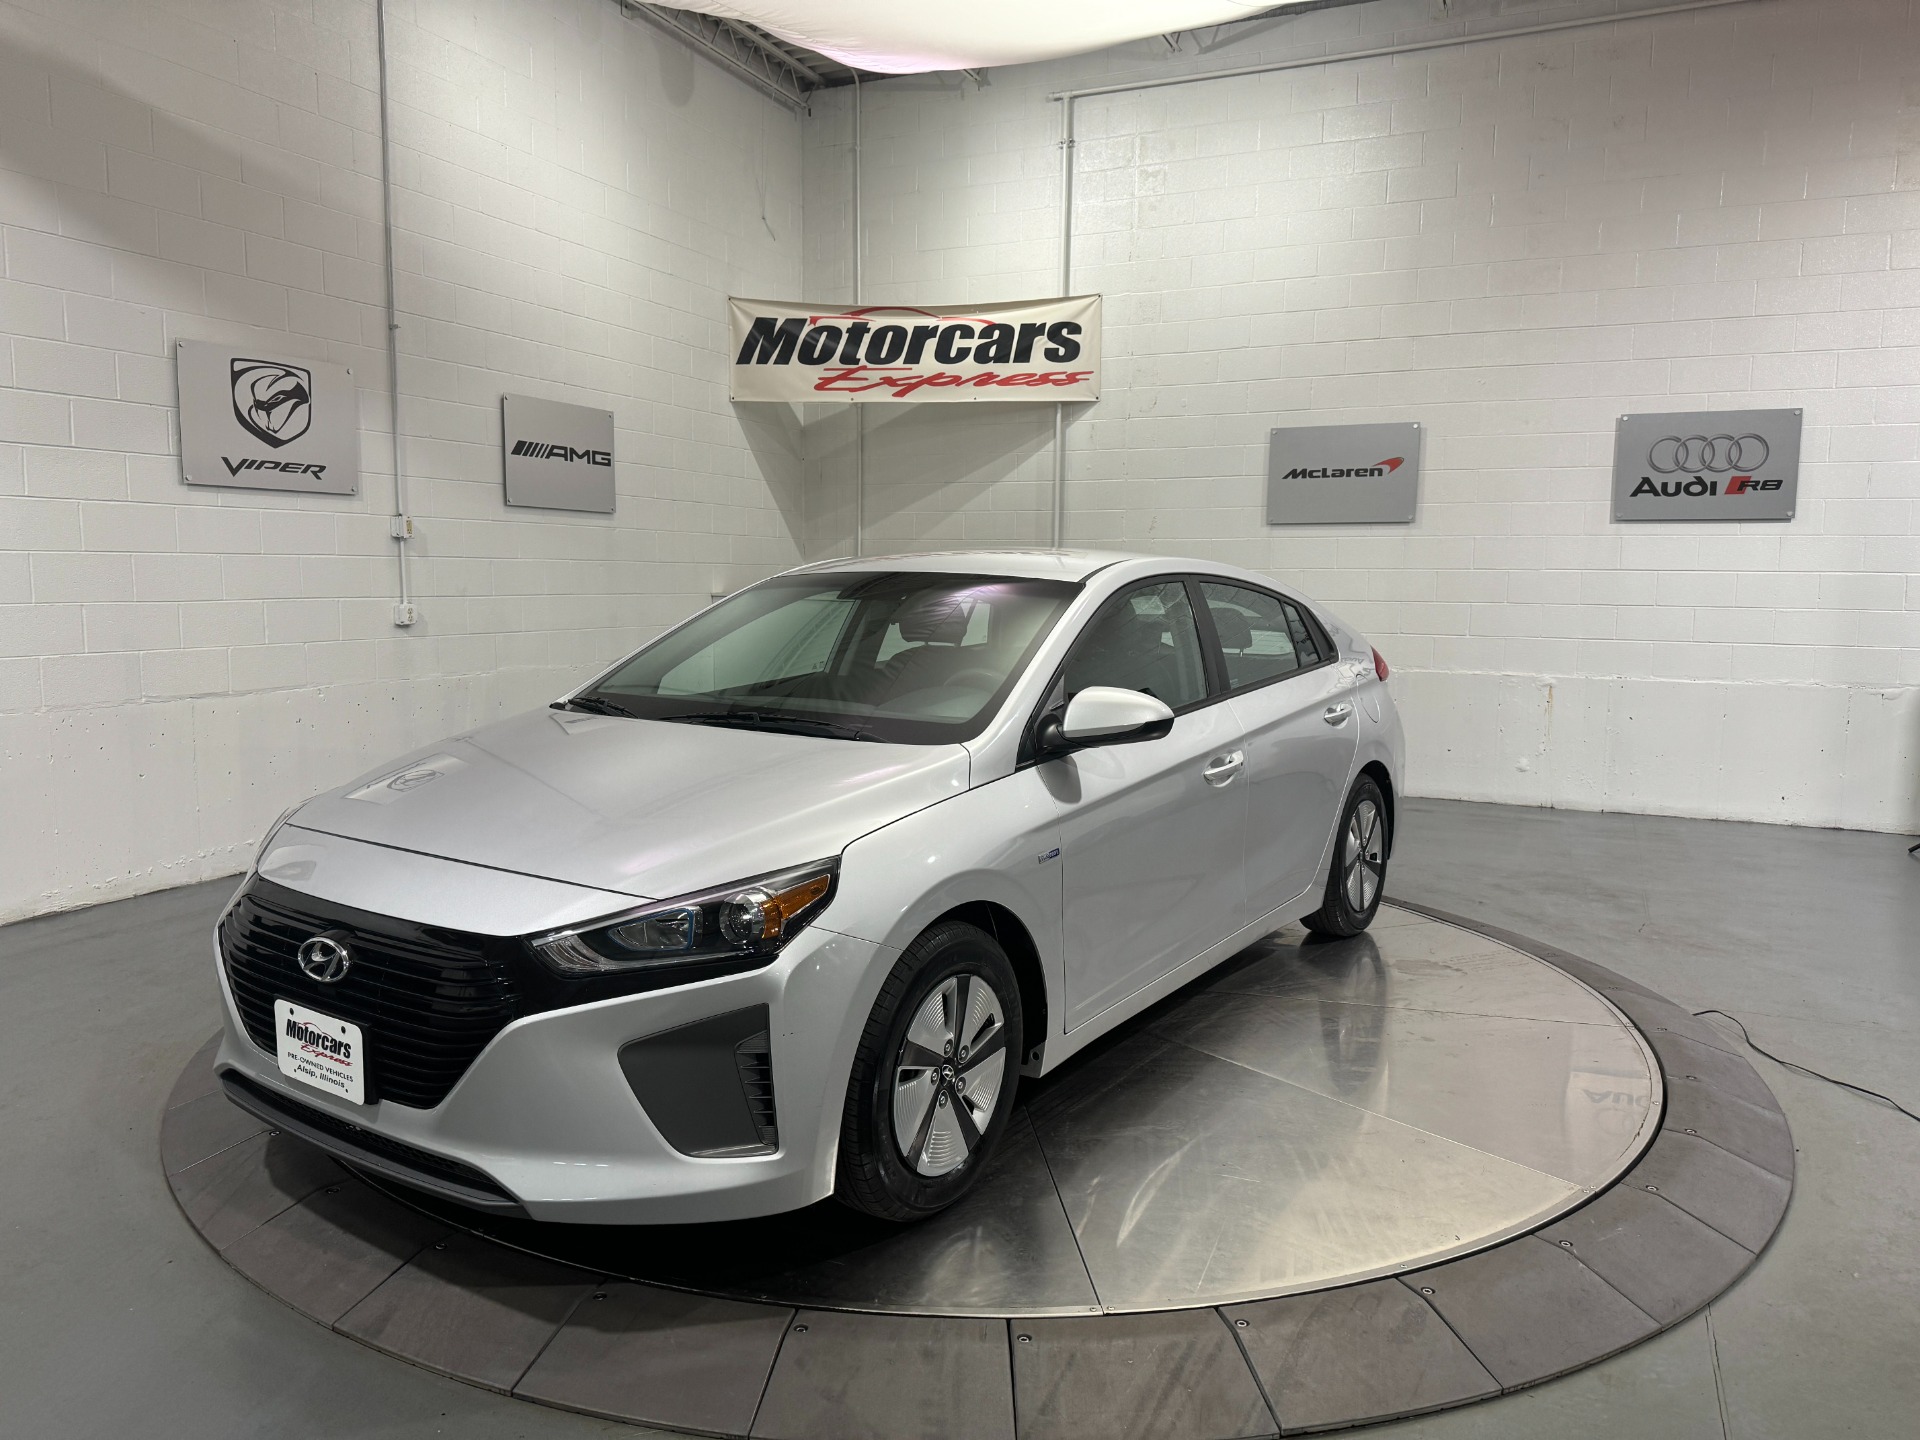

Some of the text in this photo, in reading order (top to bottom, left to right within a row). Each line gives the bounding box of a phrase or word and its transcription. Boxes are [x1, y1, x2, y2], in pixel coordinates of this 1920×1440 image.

[735, 317, 1083, 366] Motorcars
[814, 365, 1095, 398] Express
[545, 445, 612, 467] AMG
[221, 457, 327, 481] VIPER
[1282, 467, 1383, 480] McLaren
[1629, 476, 1784, 497] Audi R8
[286, 1018, 352, 1059] Motorcars
[287, 1051, 354, 1082] PRE-OWNED VEHICLES
[300, 1043, 353, 1067] Express
[296, 1064, 345, 1089] Alsip, Illinois
